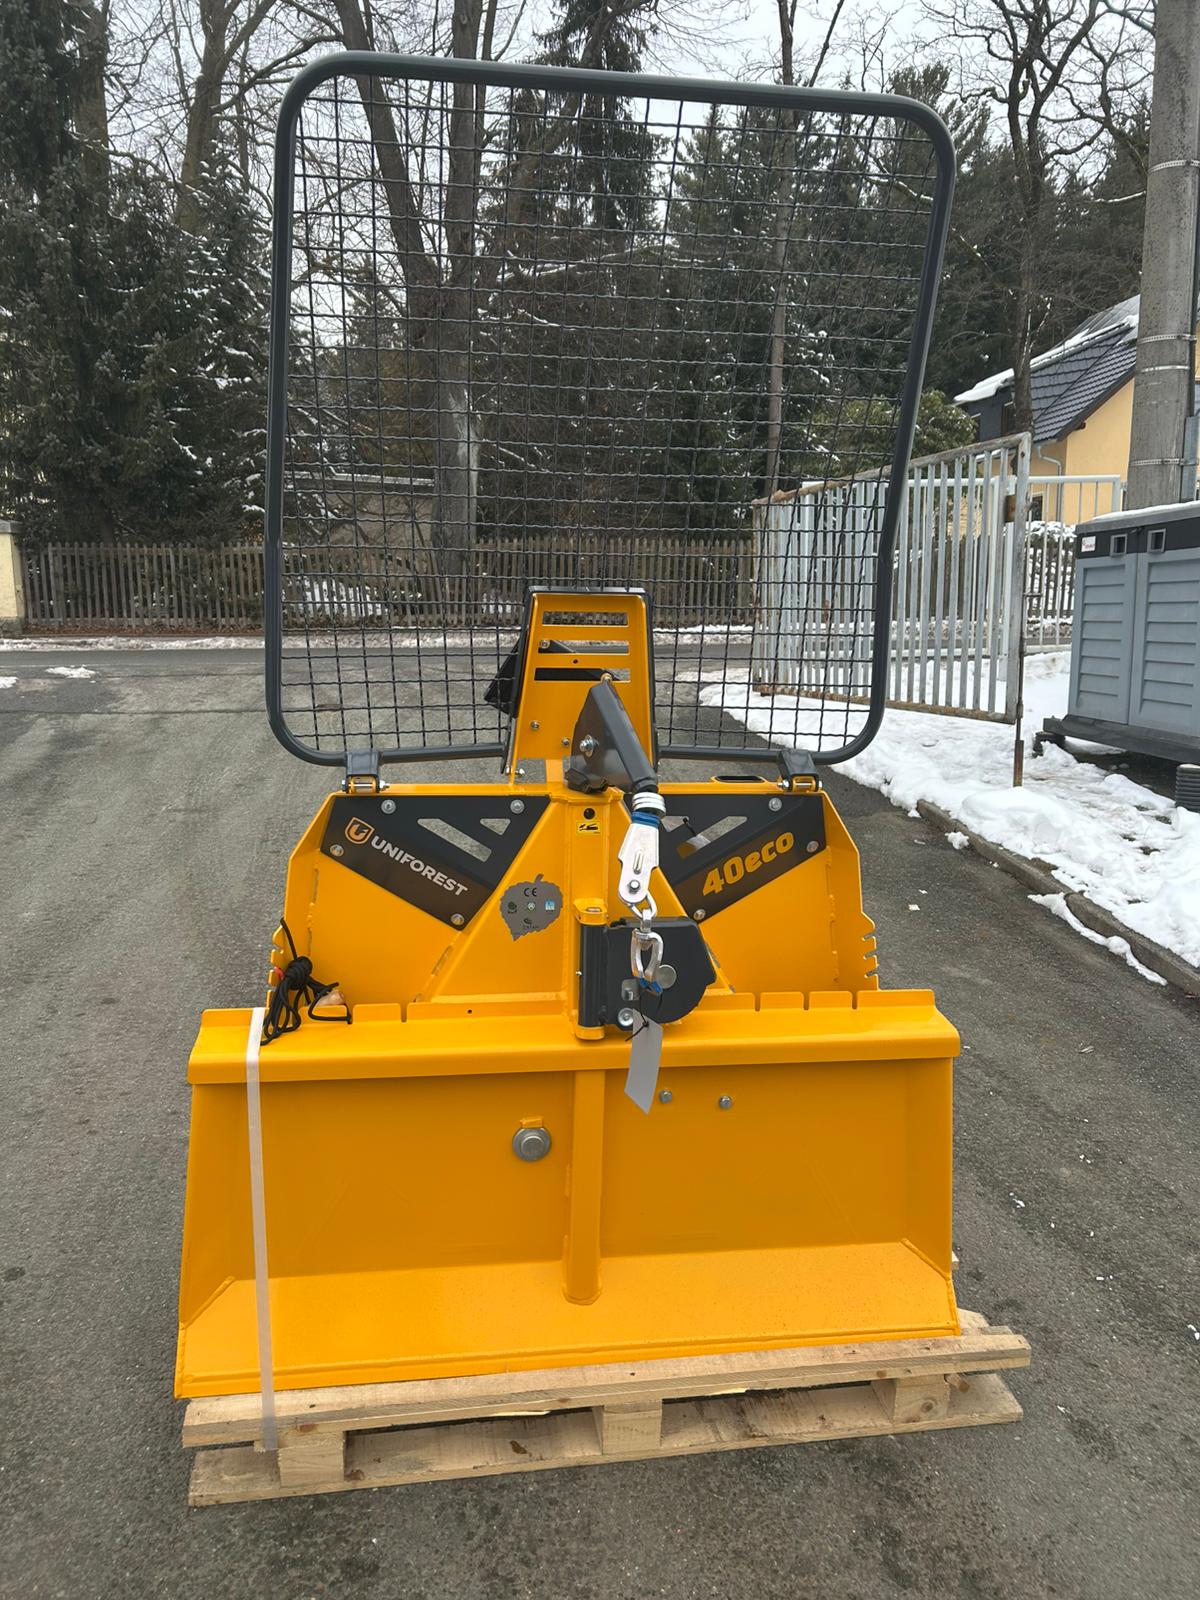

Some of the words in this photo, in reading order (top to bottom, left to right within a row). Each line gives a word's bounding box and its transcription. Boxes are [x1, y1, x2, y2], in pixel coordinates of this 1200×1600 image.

[371, 835, 468, 896] UNIFOREST
[523, 887, 538, 897] CE
[702, 832, 795, 896] 40eco
